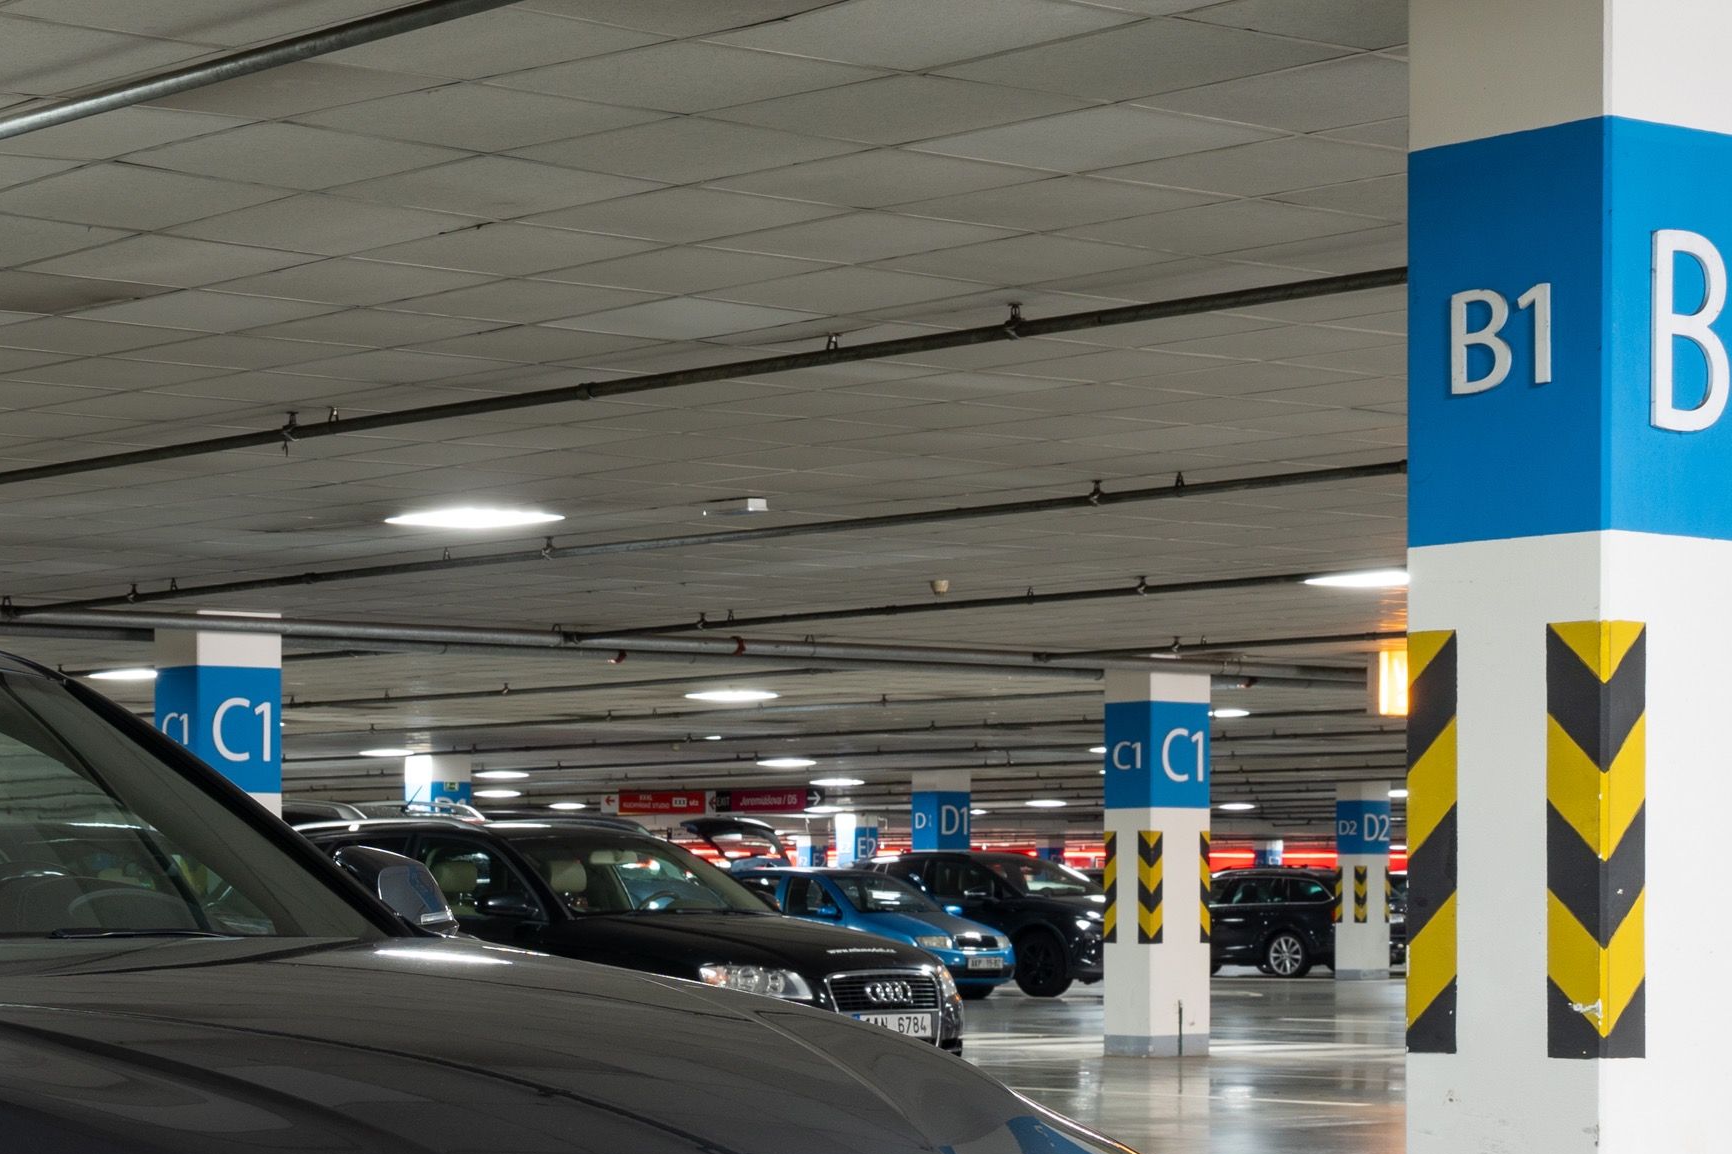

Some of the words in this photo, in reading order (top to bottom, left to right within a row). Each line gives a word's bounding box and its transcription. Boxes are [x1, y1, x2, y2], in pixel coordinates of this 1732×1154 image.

[1450, 282, 1552, 395] B1
[212, 697, 272, 762] C1
[1112, 741, 1142, 770] C1
[1161, 727, 1204, 783] C1
[941, 805, 969, 836] D1
[1338, 820, 1357, 836] D2
[1363, 813, 1390, 842] D2
[858, 837, 877, 858] E2
[898, 1015, 928, 1034] 6784
